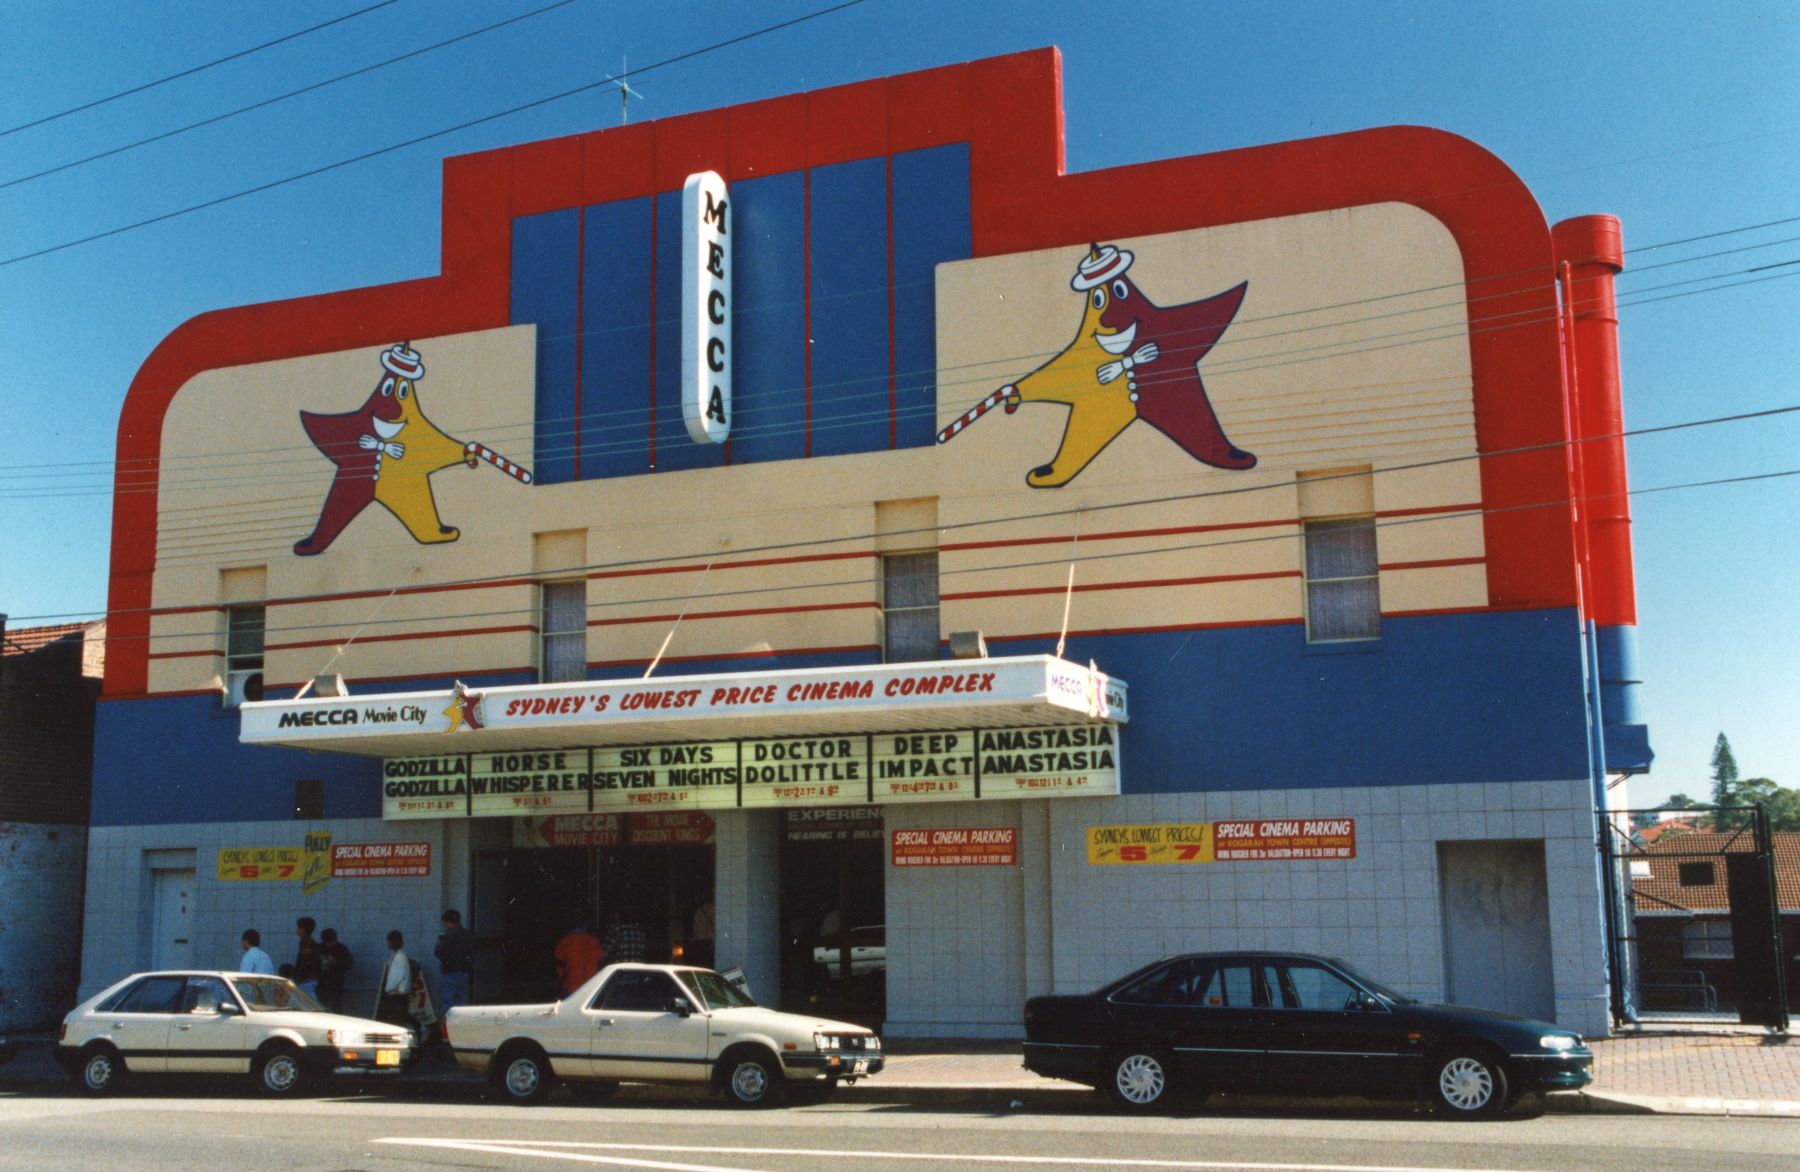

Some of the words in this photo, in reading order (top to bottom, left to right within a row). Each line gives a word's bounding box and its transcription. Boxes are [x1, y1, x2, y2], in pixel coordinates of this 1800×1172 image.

[703, 190, 727, 424] MECCA
[506, 694, 608, 715] SYDNEY'S
[619, 689, 700, 711] LOWEST
[710, 685, 775, 706] PRICE
[787, 679, 873, 702] CINEMA
[884, 673, 996, 697] COMPLEX
[1051, 673, 1082, 695] MECCA
[278, 708, 358, 728] MECCA
[362, 706, 398, 724] Movie
[400, 705, 427, 724] City
[894, 736, 958, 756] DEEP
[981, 728, 1113, 752] ANASTASIA
[620, 748, 651, 766] SIX
[660, 745, 713, 765] DAYS
[754, 740, 851, 761] DOCTOR
[385, 758, 465, 778] GODZILLA
[492, 752, 566, 772] HORSE
[879, 756, 973, 778] IMPACT
[982, 750, 1115, 775] ANASTASIA
[594, 770, 656, 790] SEVEN
[668, 765, 738, 787] NIGHTS
[746, 761, 858, 784] DOLITTLE
[385, 778, 466, 798] GODZILLA
[471, 772, 591, 794] WHISPERER
[554, 815, 619, 832] MECCA
[646, 815, 660, 826] THE
[664, 814, 688, 826] MOVIE
[1217, 824, 1254, 838] SPECIAL
[1260, 822, 1299, 836] CINEMA
[1303, 821, 1350, 835] PARKING
[554, 832, 587, 846] MOVIE
[593, 831, 619, 844] CITY
[633, 829, 672, 842] DISCOUNT
[675, 828, 701, 841] KINGS
[788, 830, 832, 841] HEARING
[837, 830, 847, 840] IS
[895, 832, 928, 845] SPECIAL
[932, 830, 967, 844] CINEMA
[970, 829, 1012, 843] PARKING
[1267, 837, 1289, 846] TOWN
[335, 846, 362, 858] SPECIAL
[364, 845, 392, 857] CINEMA
[394, 844, 428, 857] PARKING
[1174, 845, 1200, 860] 7
